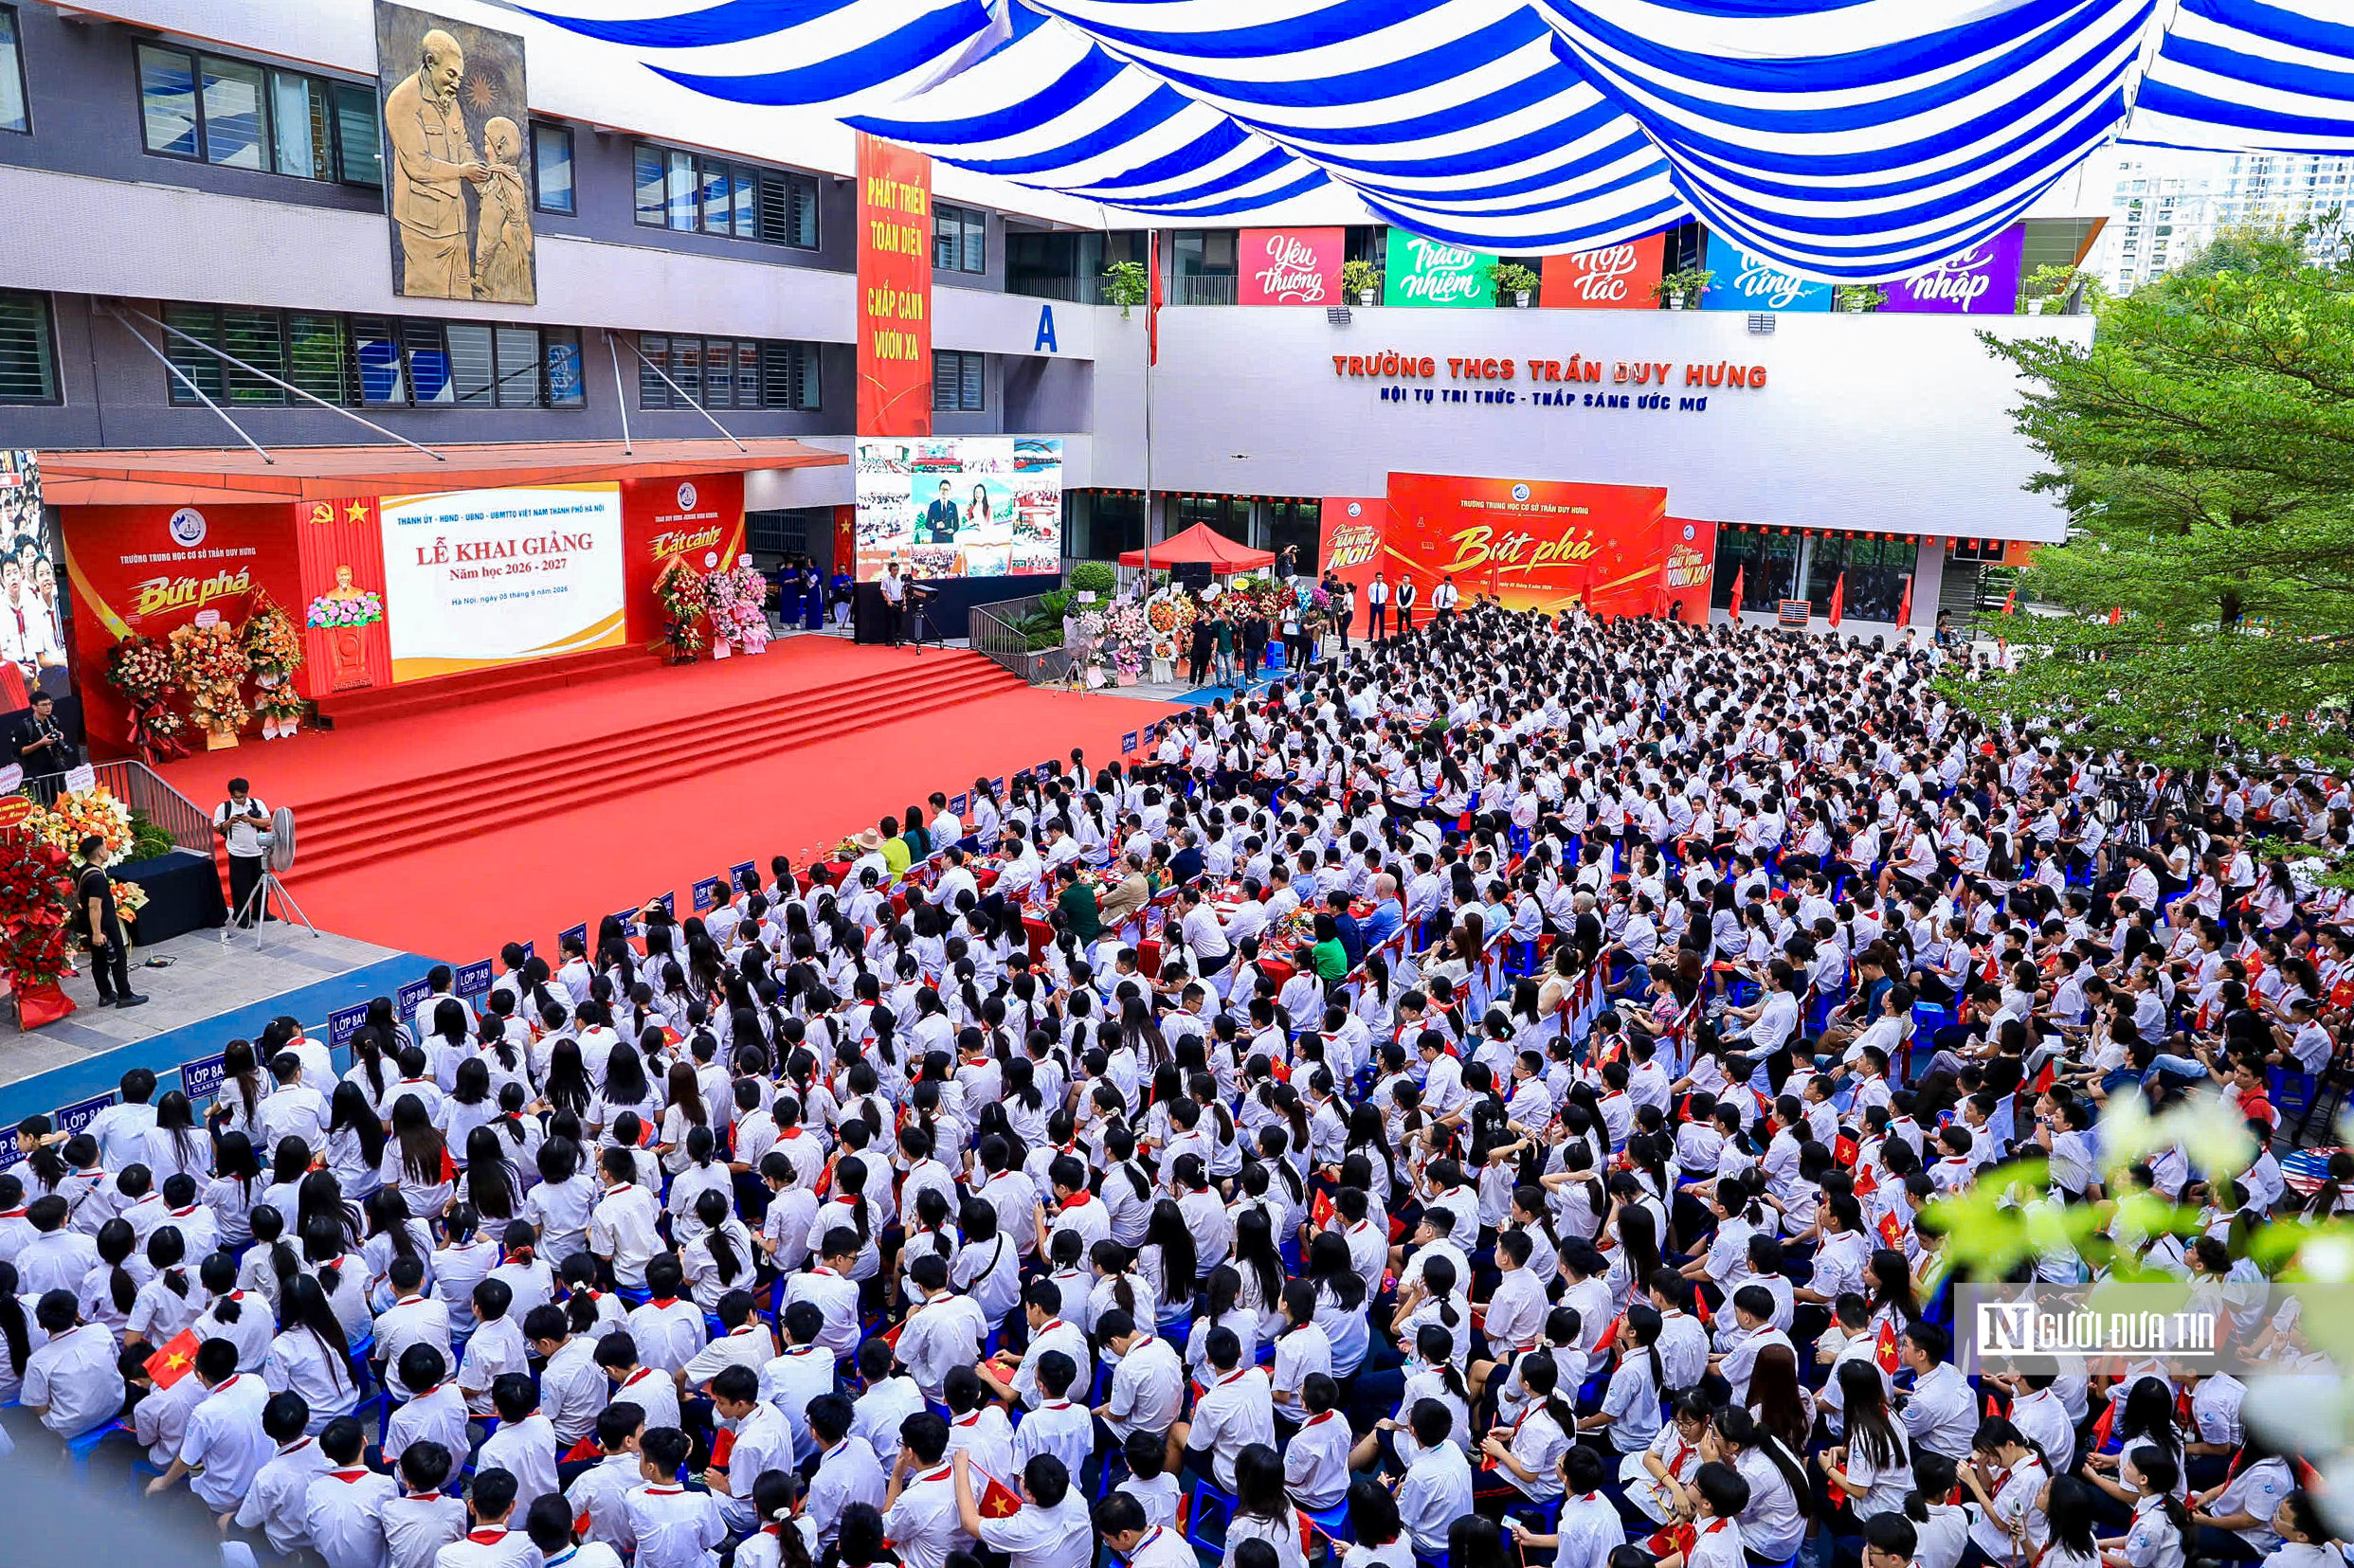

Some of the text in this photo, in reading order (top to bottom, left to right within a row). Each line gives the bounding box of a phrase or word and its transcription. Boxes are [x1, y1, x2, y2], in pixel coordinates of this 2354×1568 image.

[867, 173, 926, 215] PHÁT TRIỂN
[871, 216, 923, 261] TOÀN DIỆN
[1266, 235, 1317, 272] Yêu
[868, 279, 924, 320] CHẮP CÁNH
[1256, 267, 1326, 302] thương
[1400, 268, 1481, 301] nhiệm
[1574, 272, 1628, 301] tác
[1905, 268, 1990, 313] nhập
[1034, 304, 1058, 352] A
[875, 329, 919, 361] VƯƠN XA
[1332, 350, 1767, 387] TRƯỜNG THCS TRẦN DUY HƯNG
[1381, 386, 1406, 403] HỘI
[1414, 388, 1434, 404] TỤ
[1441, 389, 1468, 403] TRI
[1475, 387, 1515, 404] THỨC
[1532, 388, 1576, 406] THẮP
[1584, 391, 1630, 408] SÁNG
[1638, 392, 1671, 409] ƯỚC
[1679, 396, 1708, 411] MƠ
[1486, 501, 1506, 510] TRUNG
[1507, 502, 1519, 512] HỌC
[149, 552, 171, 564] TRUNG
[172, 551, 186, 562] HỌC
[416, 530, 593, 566] LỄ KHAI GIẢNG
[653, 530, 687, 560] Cất
[686, 525, 723, 548] cánh
[1439, 525, 1603, 579] Bứt phá
[450, 568, 479, 581] Năm
[481, 567, 502, 579] học
[506, 562, 532, 575] 2026
[542, 558, 567, 571] 2027
[136, 566, 250, 615] Bứt phá
[733, 870, 743, 883] LỚ
[461, 968, 489, 986] LỚP 7A9
[403, 990, 417, 1006] LỚP
[335, 1012, 366, 1033] LỚP 8A1
[189, 1066, 209, 1086] LỚP
[193, 1081, 214, 1093] CLASS
[63, 1111, 87, 1131] LỚP
